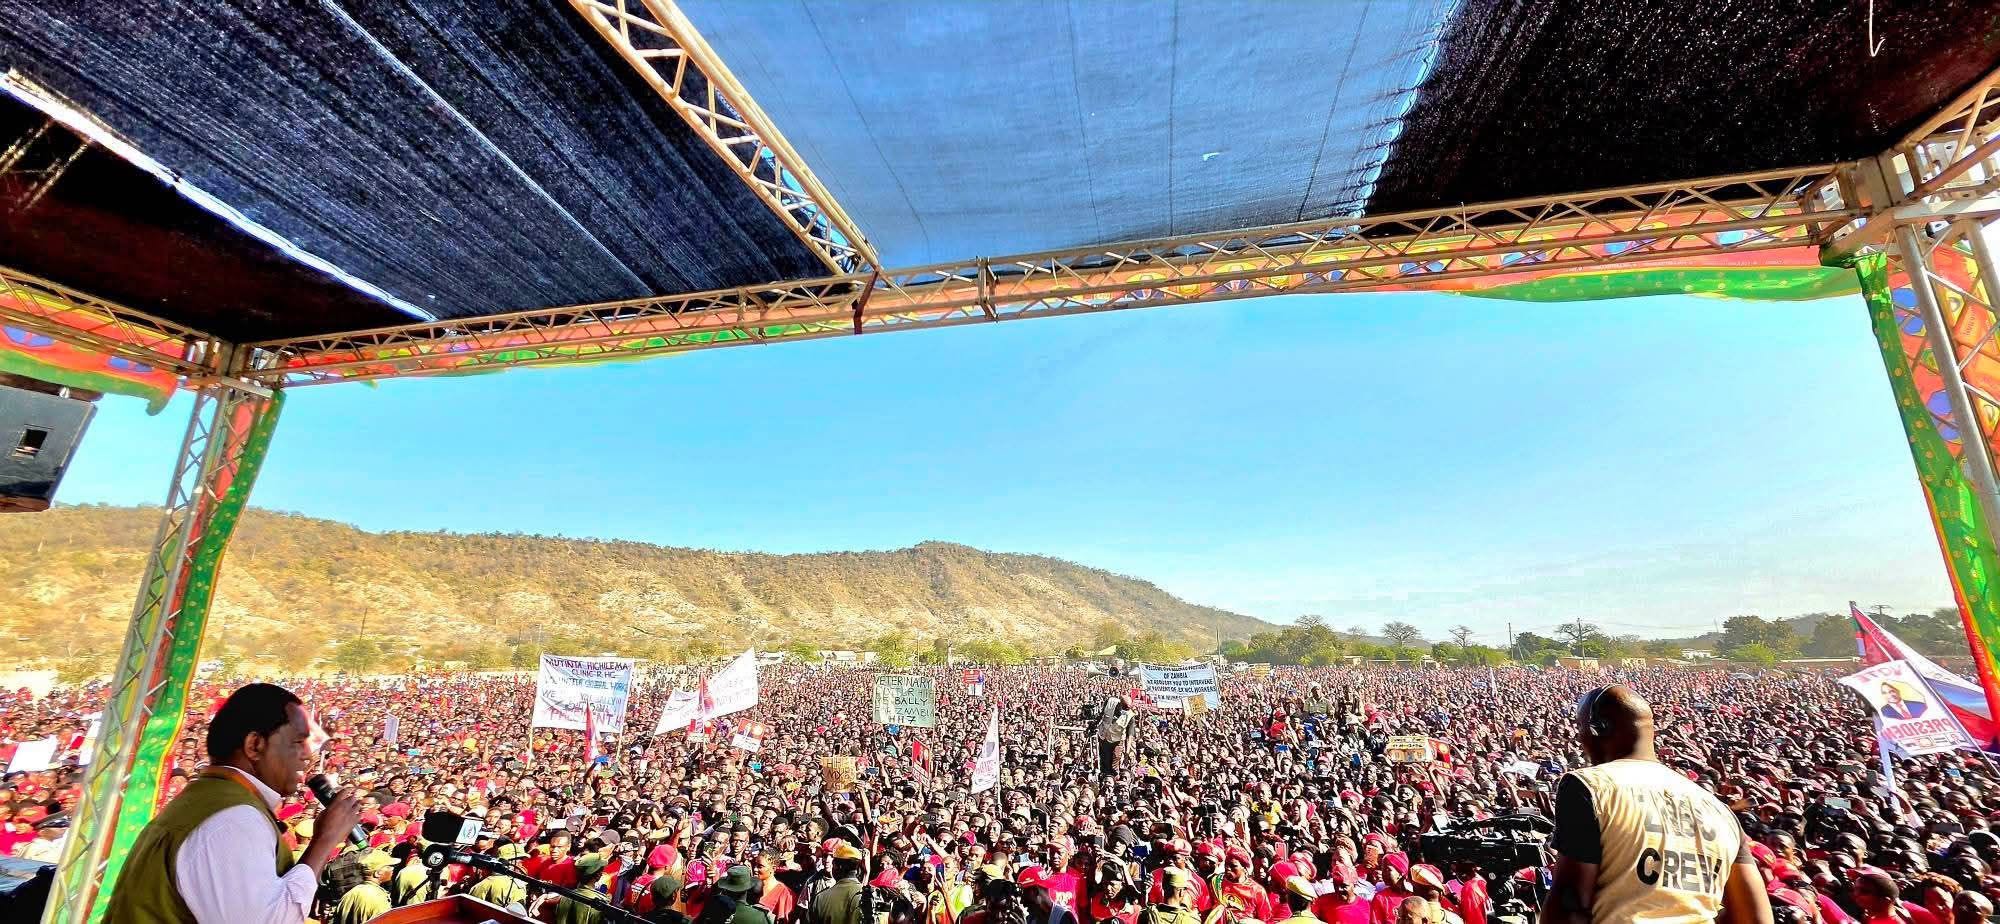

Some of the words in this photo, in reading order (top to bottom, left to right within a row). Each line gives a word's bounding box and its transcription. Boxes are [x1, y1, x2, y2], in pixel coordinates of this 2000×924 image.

[587, 660, 628, 671] HICHILEMA
[571, 668, 594, 678] CLINIC
[874, 675, 932, 689] VETERINARY
[1194, 685, 1216, 693] WORKERS
[894, 696, 928, 706] BALLY
[1637, 847, 1722, 894] CREW
